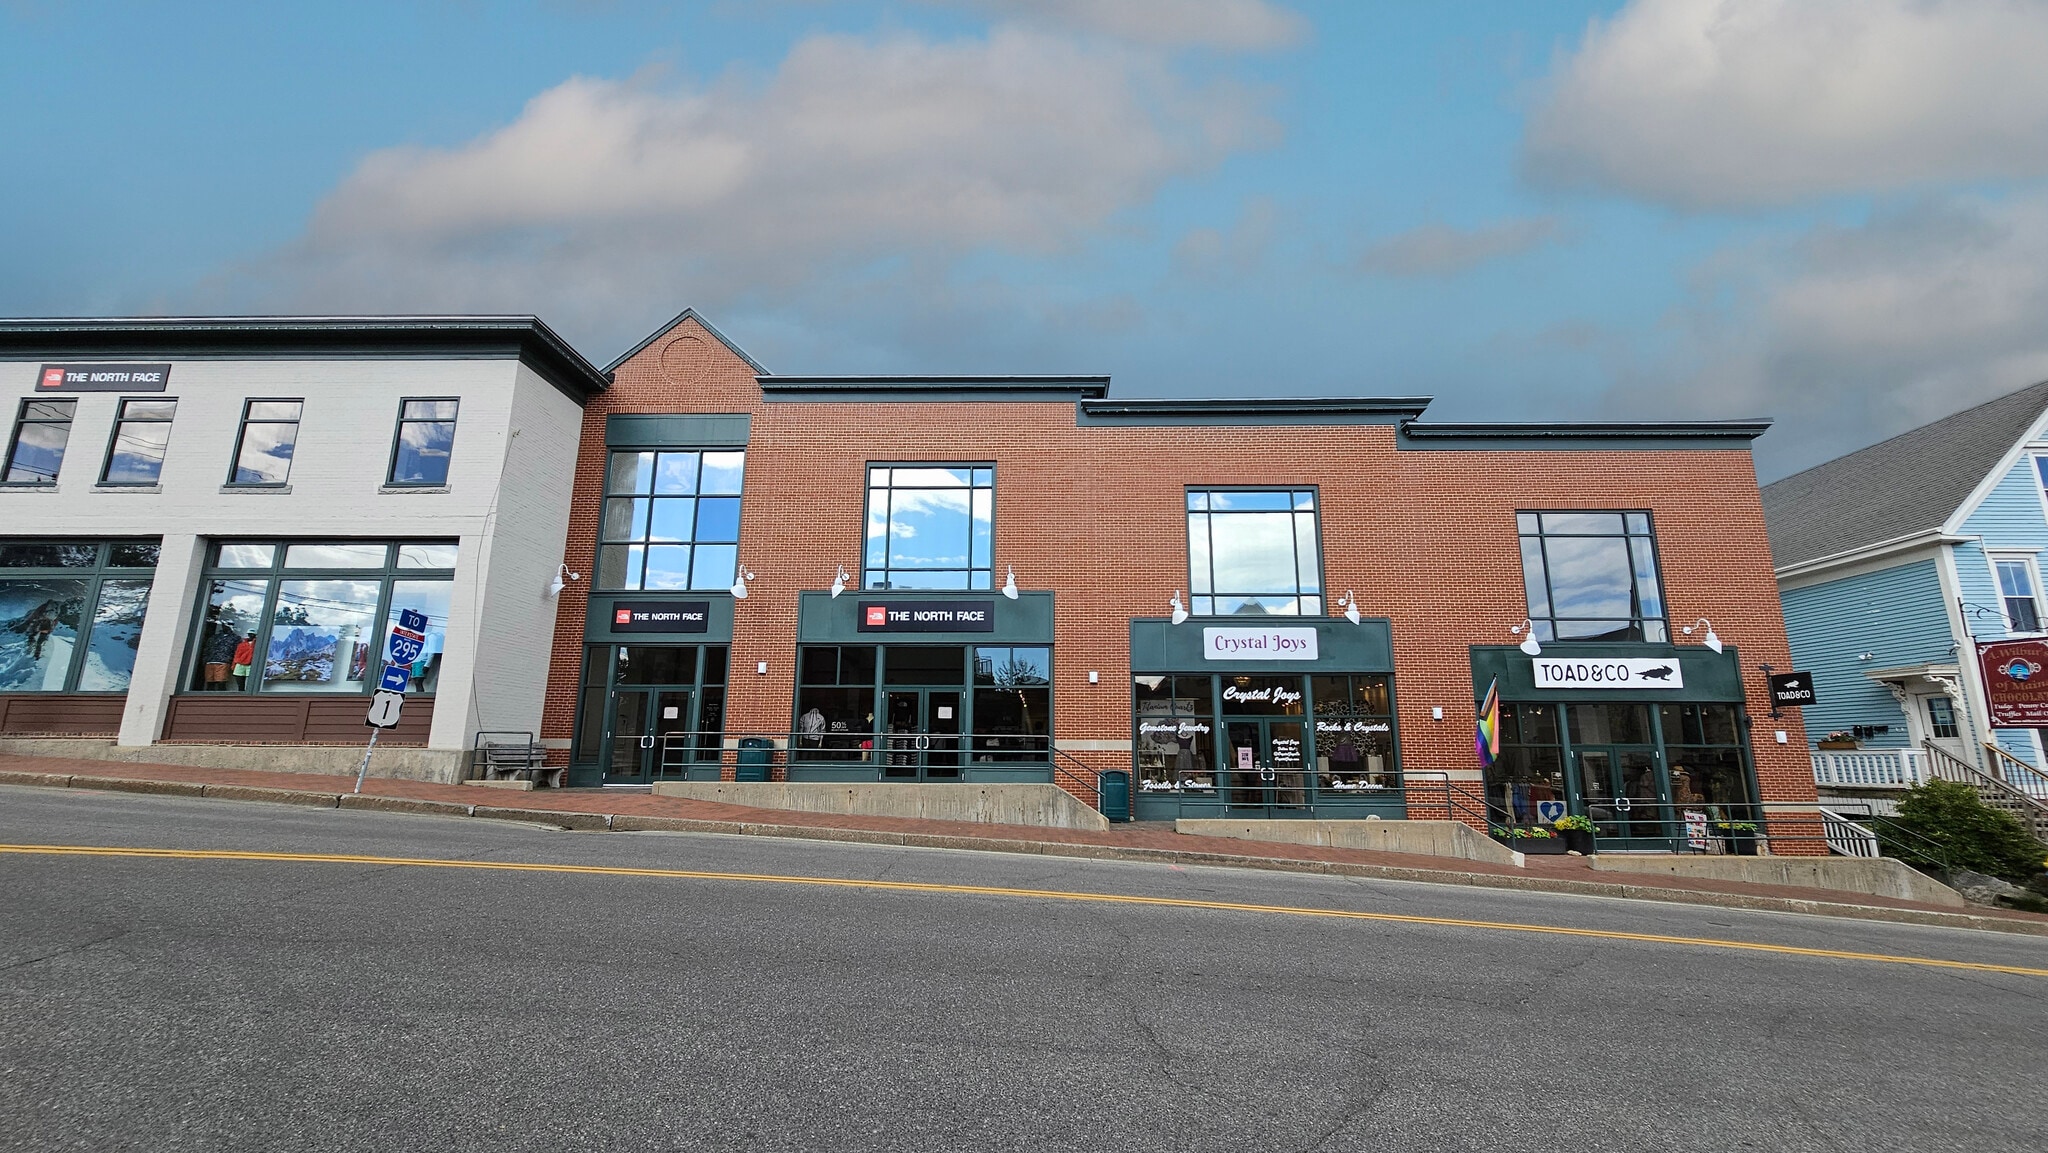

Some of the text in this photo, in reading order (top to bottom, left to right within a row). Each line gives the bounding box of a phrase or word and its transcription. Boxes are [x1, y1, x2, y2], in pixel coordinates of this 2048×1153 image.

[66, 373, 161, 382] THE NORTH FACE
[409, 615, 420, 627] TO
[633, 613, 703, 621] THE NORTH FACE
[888, 611, 985, 621] THE NORTH FACE
[392, 640, 419, 660] 295
[1215, 635, 1307, 653] Crystal Joys
[1540, 664, 1629, 682] TOAD&CO
[1996, 681, 2009, 692] of
[1223, 686, 1301, 704] Crystal Joys
[1776, 690, 1811, 700] TOAD&CO
[382, 700, 391, 720] 1
[2018, 703, 2039, 711] Penny
[1139, 722, 1210, 735] Gemstone Jewelry
[1316, 721, 1390, 734] Rocks & Crystals
[1142, 779, 1172, 791] Fossils
[1184, 779, 1212, 789] Stones
[1332, 780, 1384, 790] Home Decor
